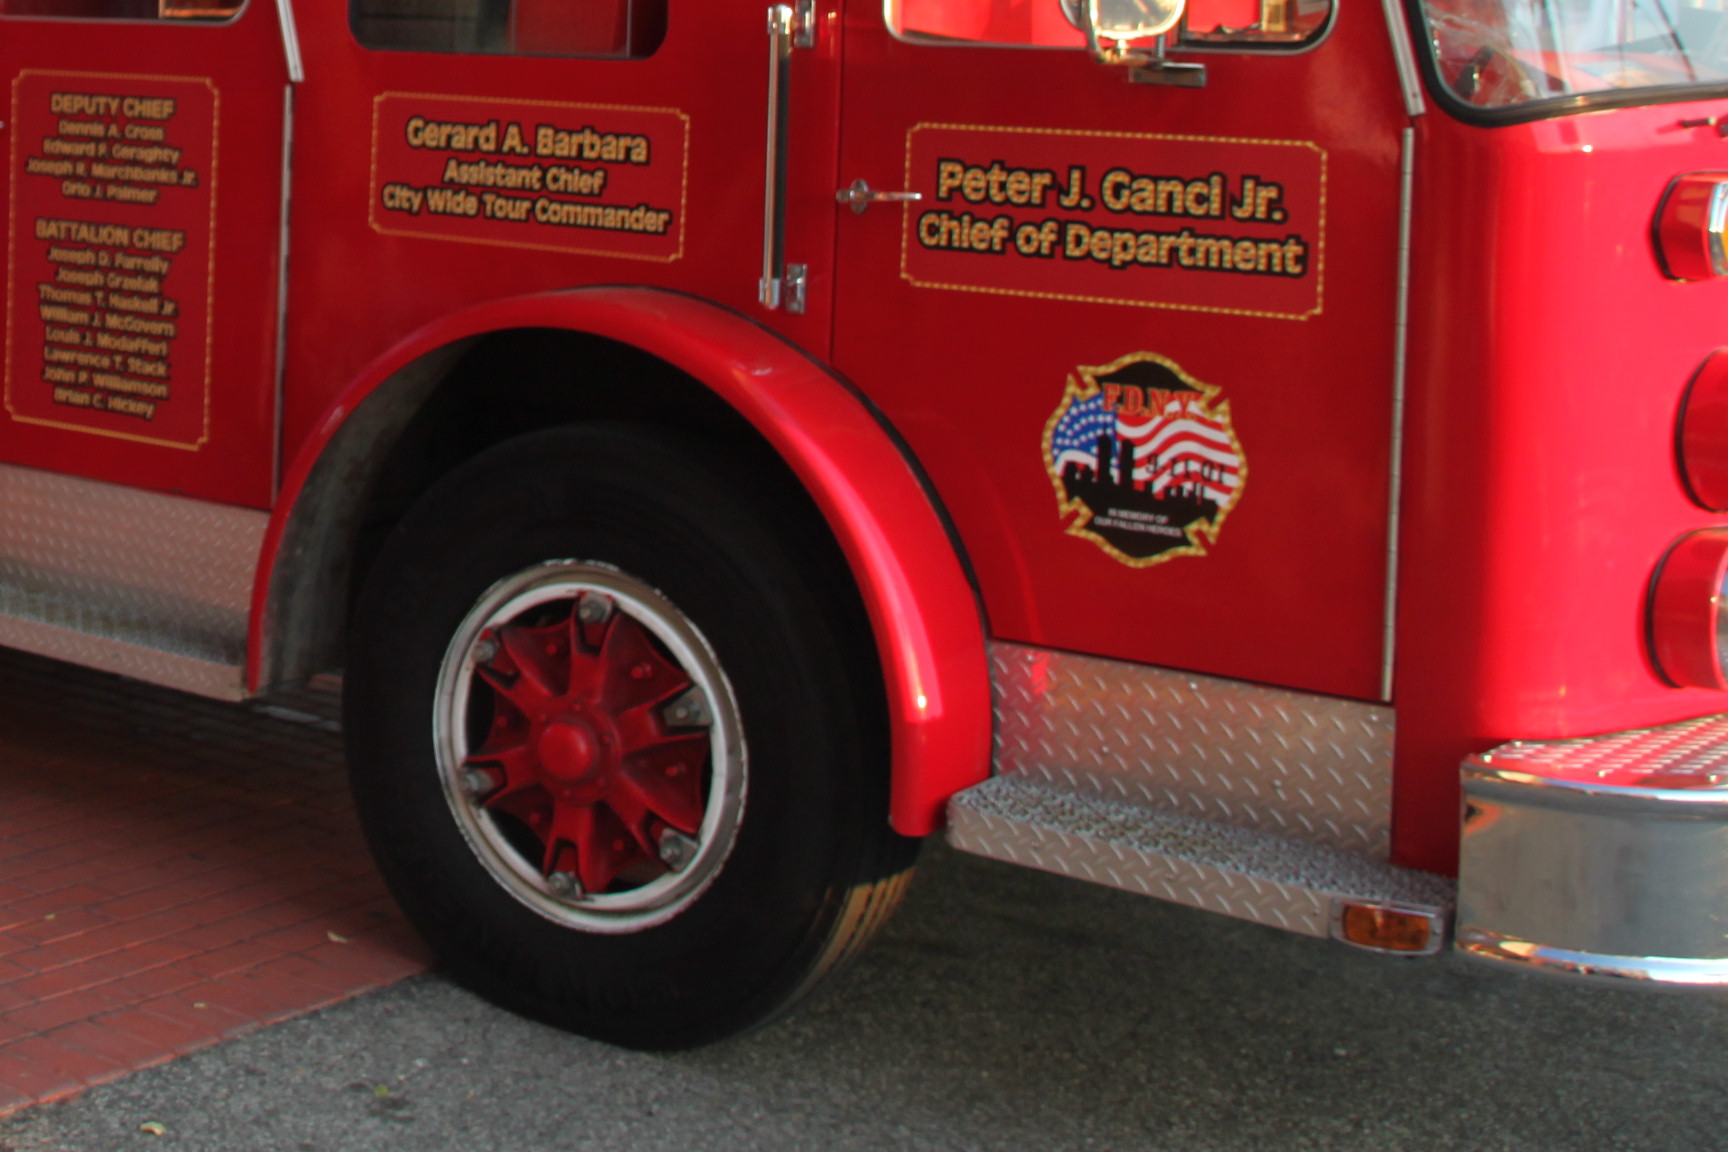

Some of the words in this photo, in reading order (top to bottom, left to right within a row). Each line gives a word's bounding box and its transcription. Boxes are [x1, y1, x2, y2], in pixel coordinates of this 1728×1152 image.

[50, 92, 121, 116] DEPUTY
[123, 97, 175, 120] CHIEF
[406, 116, 498, 153] Gerard
[502, 122, 530, 155] A.
[536, 124, 650, 165] Barbara
[443, 158, 542, 190] Assistant
[545, 165, 606, 196] Chief
[937, 159, 1053, 207] Peter
[1058, 166, 1093, 210] J.
[1100, 168, 1225, 219] Ganci
[1231, 177, 1286, 222] Jr.
[382, 183, 422, 214] City
[426, 187, 478, 217] Wide
[482, 192, 532, 222] Tour
[534, 198, 671, 234] Commander
[36, 218, 130, 246] BATTALION
[133, 227, 185, 253] CHIEF
[918, 211, 1012, 254] Chief
[1015, 219, 1061, 258] of
[1063, 222, 1308, 276] Department
